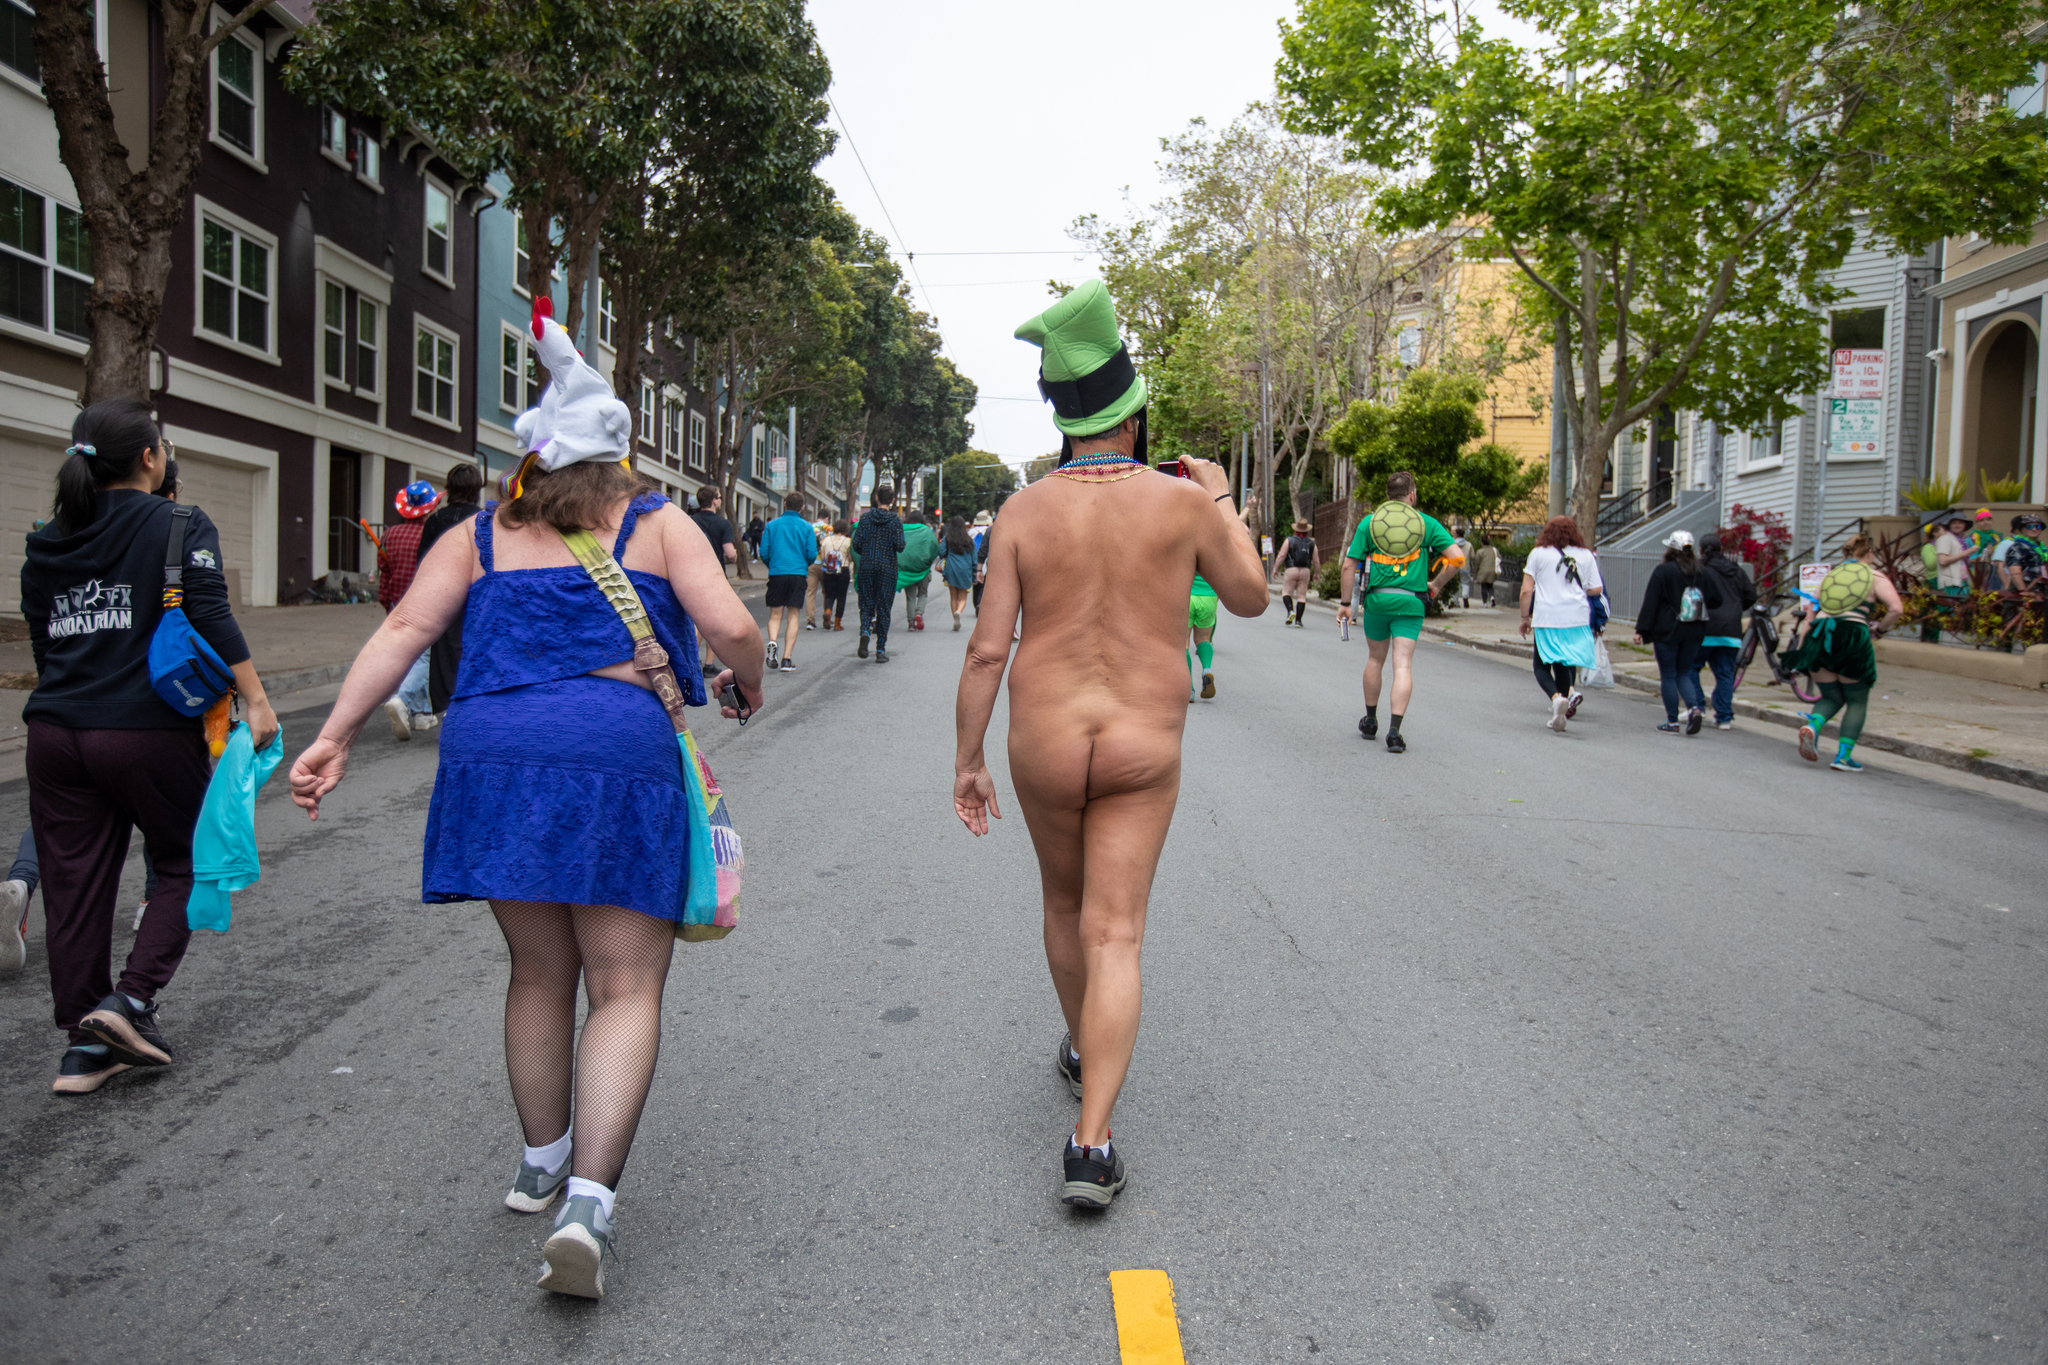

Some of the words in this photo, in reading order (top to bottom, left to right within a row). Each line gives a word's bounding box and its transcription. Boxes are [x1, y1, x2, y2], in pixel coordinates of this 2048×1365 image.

[1837, 351, 1850, 363] NO
[1852, 354, 1884, 364] PARKING
[1839, 379, 1853, 387] TUES
[1859, 379, 1878, 387] THURS
[1834, 401, 1845, 413] 2
